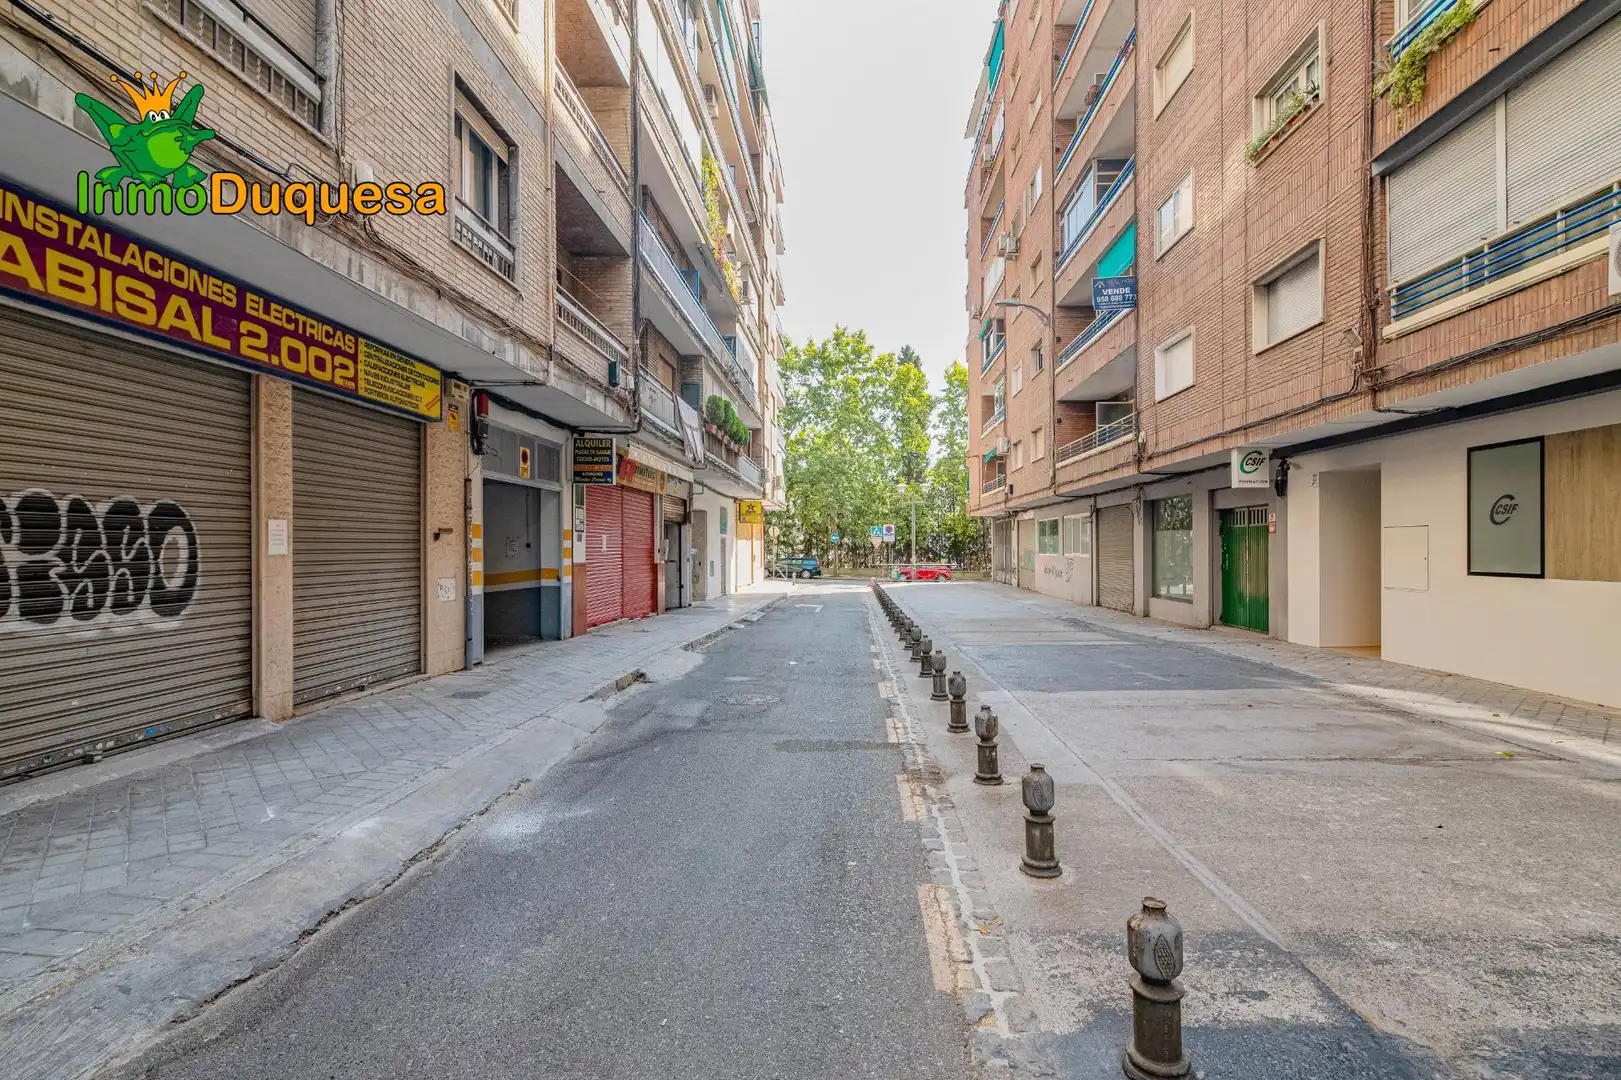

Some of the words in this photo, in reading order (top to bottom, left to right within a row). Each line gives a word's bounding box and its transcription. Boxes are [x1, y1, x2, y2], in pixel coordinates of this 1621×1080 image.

[1102, 287, 1130, 295] VENDE
[0, 230, 231, 349] ABISAL
[240, 321, 355, 389] 2.002
[246, 292, 355, 355] ELECTRICAS
[575, 439, 611, 448] ALQUILER
[1245, 457, 1266, 466] CSIF
[1495, 503, 1518, 515] CSIF
